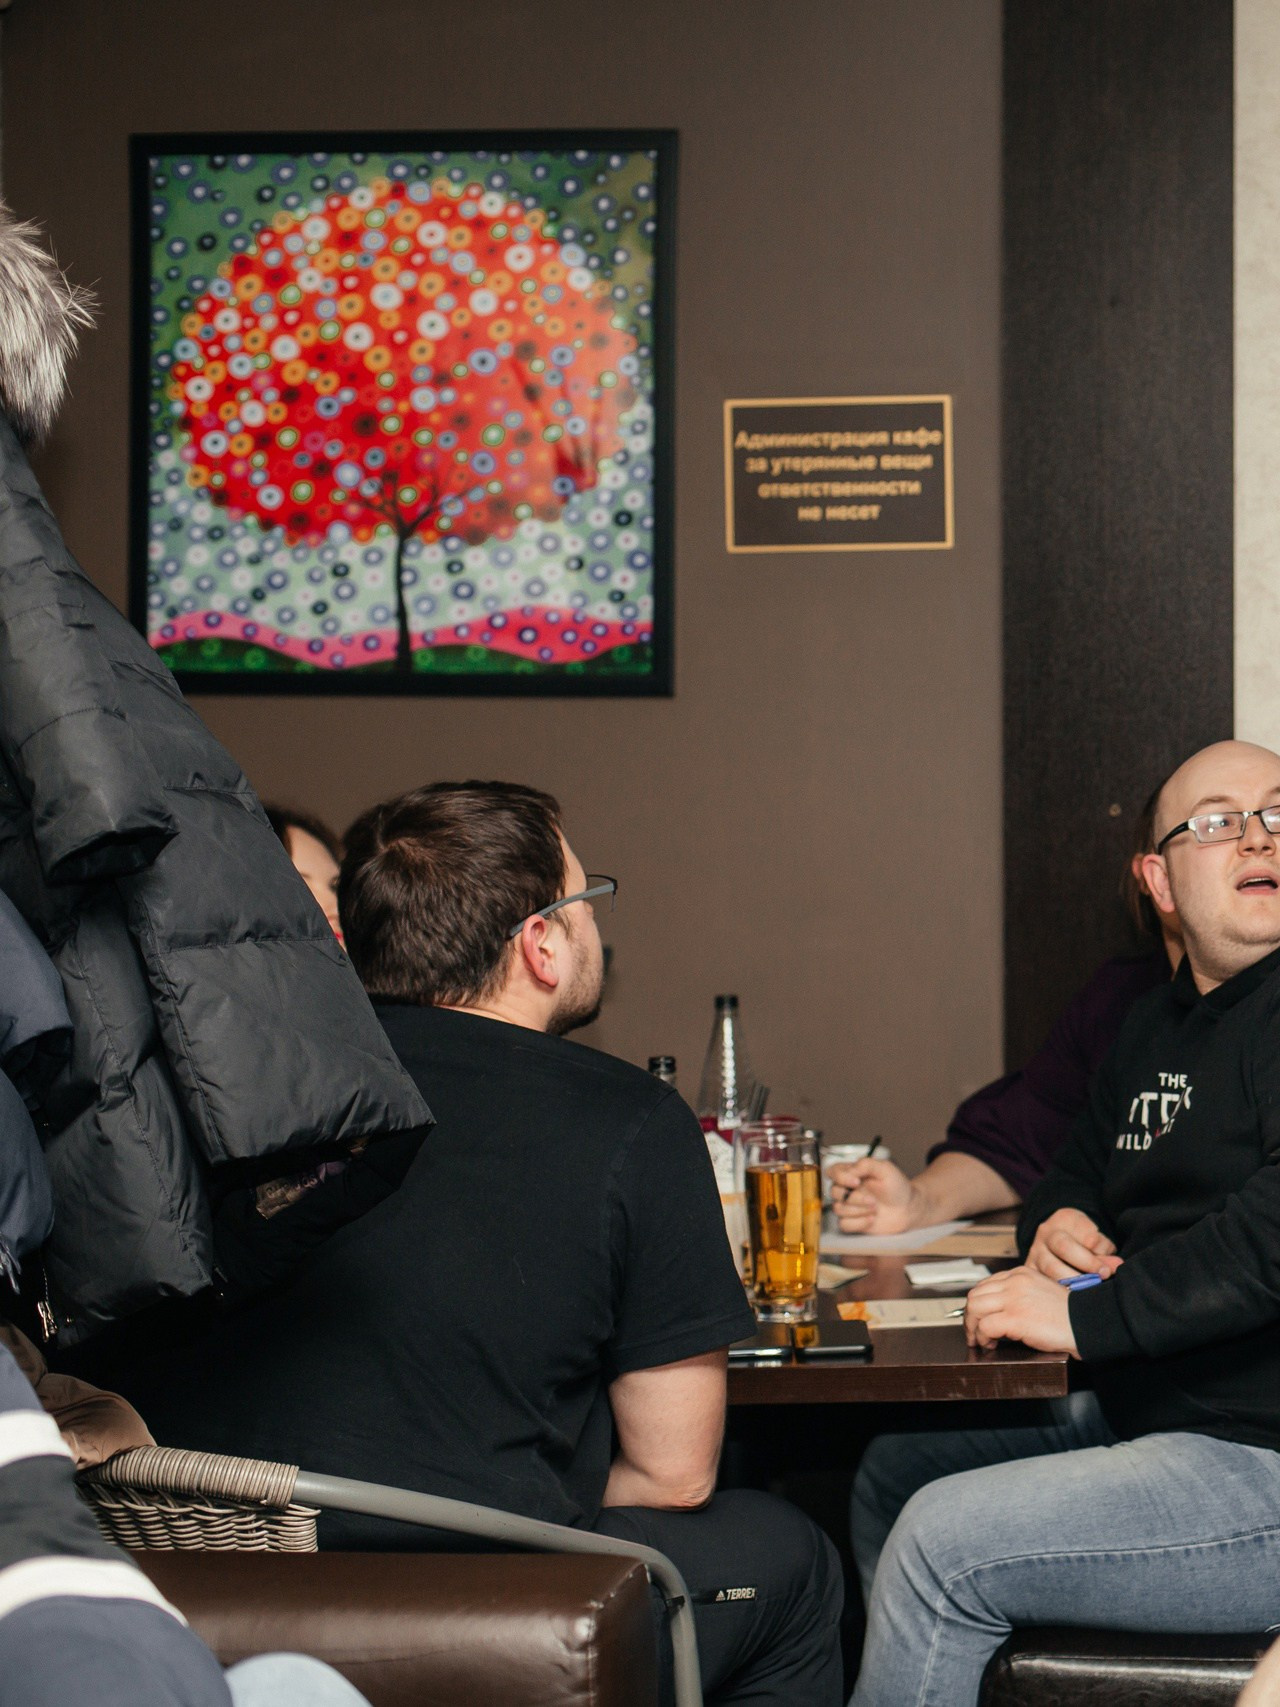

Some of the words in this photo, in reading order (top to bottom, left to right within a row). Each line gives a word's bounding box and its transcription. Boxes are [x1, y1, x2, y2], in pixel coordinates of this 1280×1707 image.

[734, 430, 890, 451] Администрация
[892, 426, 943, 449] кафе
[1158, 1072, 1188, 1089] THE
